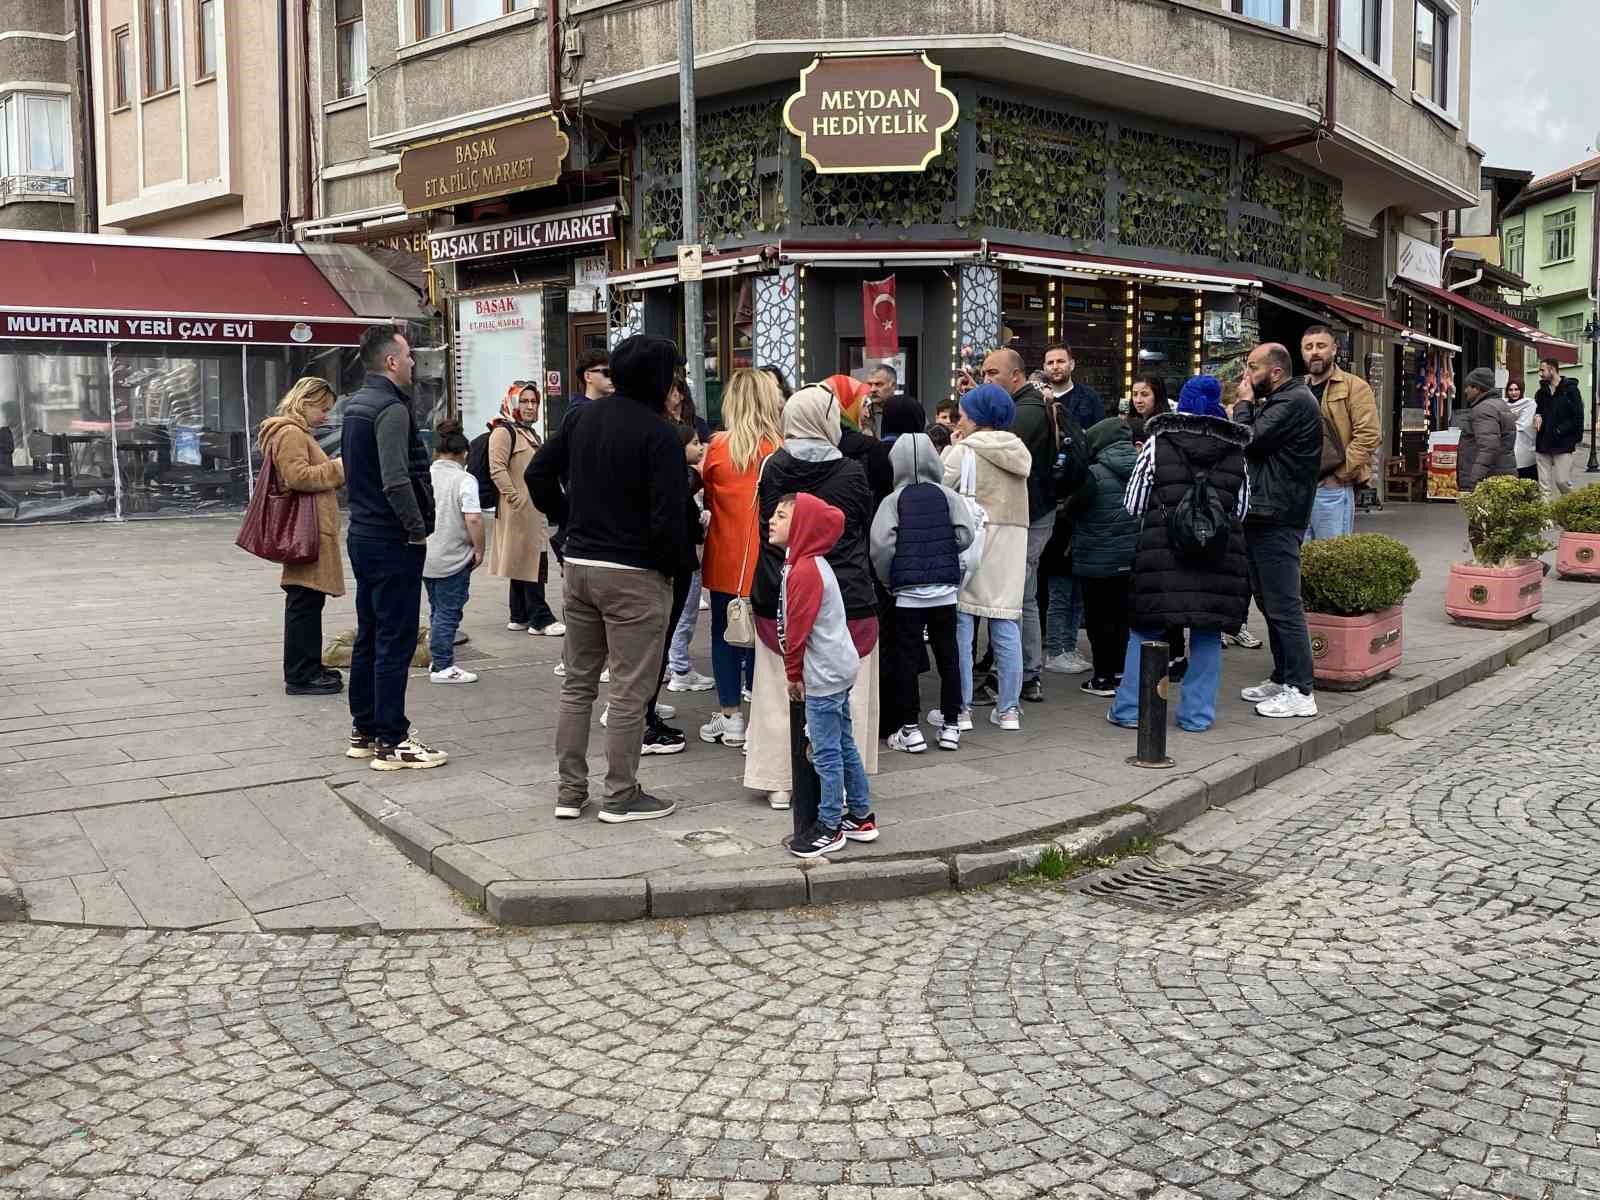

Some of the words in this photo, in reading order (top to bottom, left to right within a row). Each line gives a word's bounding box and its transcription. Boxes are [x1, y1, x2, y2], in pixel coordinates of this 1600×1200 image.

[820, 88, 921, 110] MEYDAN
[812, 110, 929, 136] HEDİYELİK
[455, 136, 497, 165] BAŞAK
[425, 177, 438, 198] ET
[440, 176, 449, 195] &
[450, 167, 480, 192] PİLİÇ
[482, 157, 534, 185] MARKET
[431, 233, 480, 260] BAŞAK
[483, 230, 500, 253] ET
[503, 223, 542, 248] PİLİÇ
[544, 213, 612, 243] MARKET
[7, 316, 120, 334] MUHTARIN
[125, 317, 172, 336] YERİ
[178, 321, 218, 340] ÇAY
[222, 320, 254, 338] EVİ
